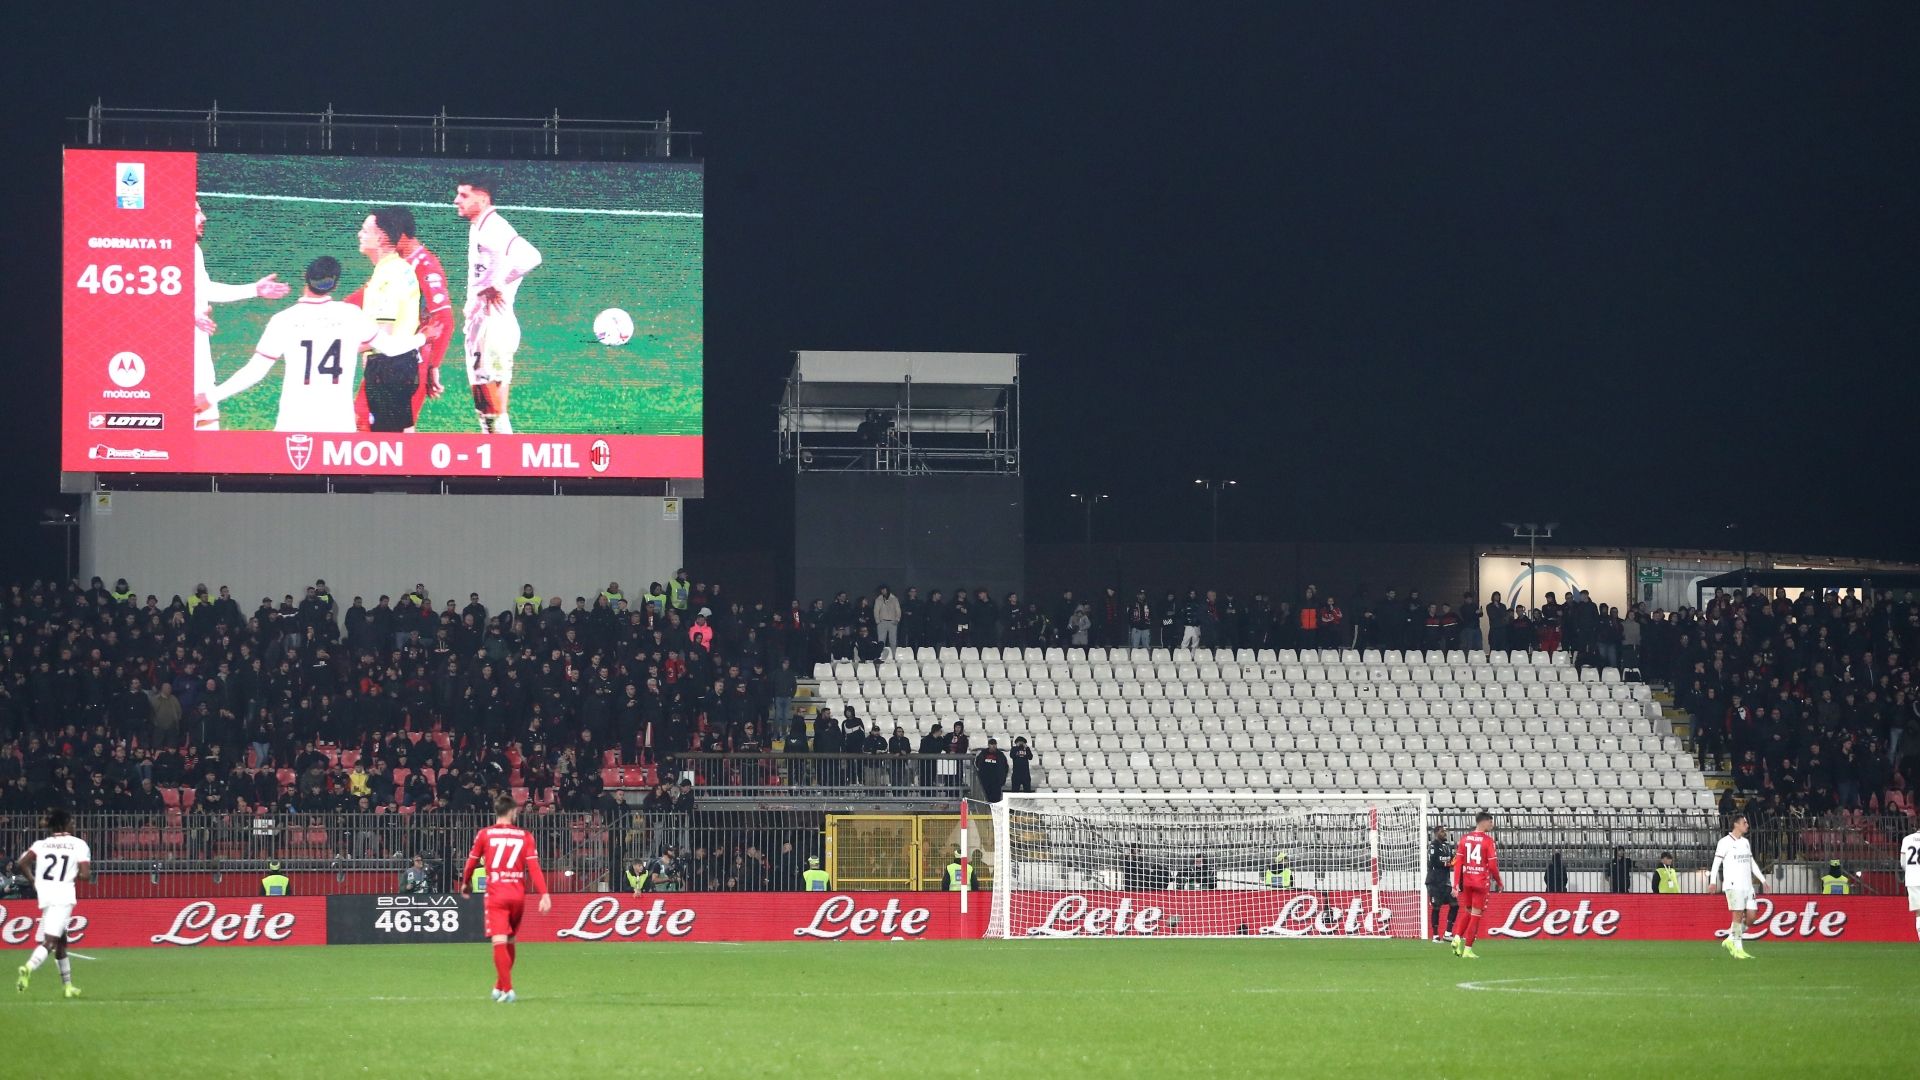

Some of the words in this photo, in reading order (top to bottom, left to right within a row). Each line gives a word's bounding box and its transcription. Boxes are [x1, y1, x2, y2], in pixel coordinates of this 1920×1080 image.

[88, 237, 157, 249] GIORNATA
[159, 239, 172, 250] 11
[76, 263, 182, 296] 46:38
[300, 338, 343, 385] 14
[103, 389, 151, 399] motorola
[107, 416, 161, 426] LOTTO
[322, 440, 403, 467] MON
[522, 442, 580, 468] MIL
[43, 853, 69, 882] 21
[490, 837, 524, 869] 77
[1464, 842, 1482, 865] 14
[1907, 845, 1920, 866] 2
[376, 896, 457, 906] BOLVA
[1027, 894, 1163, 937] Lete
[1258, 894, 1393, 936] Lete
[151, 901, 296, 945] Lete
[375, 910, 459, 933] 46:38
[557, 896, 697, 940] Lete
[793, 895, 931, 938] Lete
[1487, 896, 1621, 938] Lete
